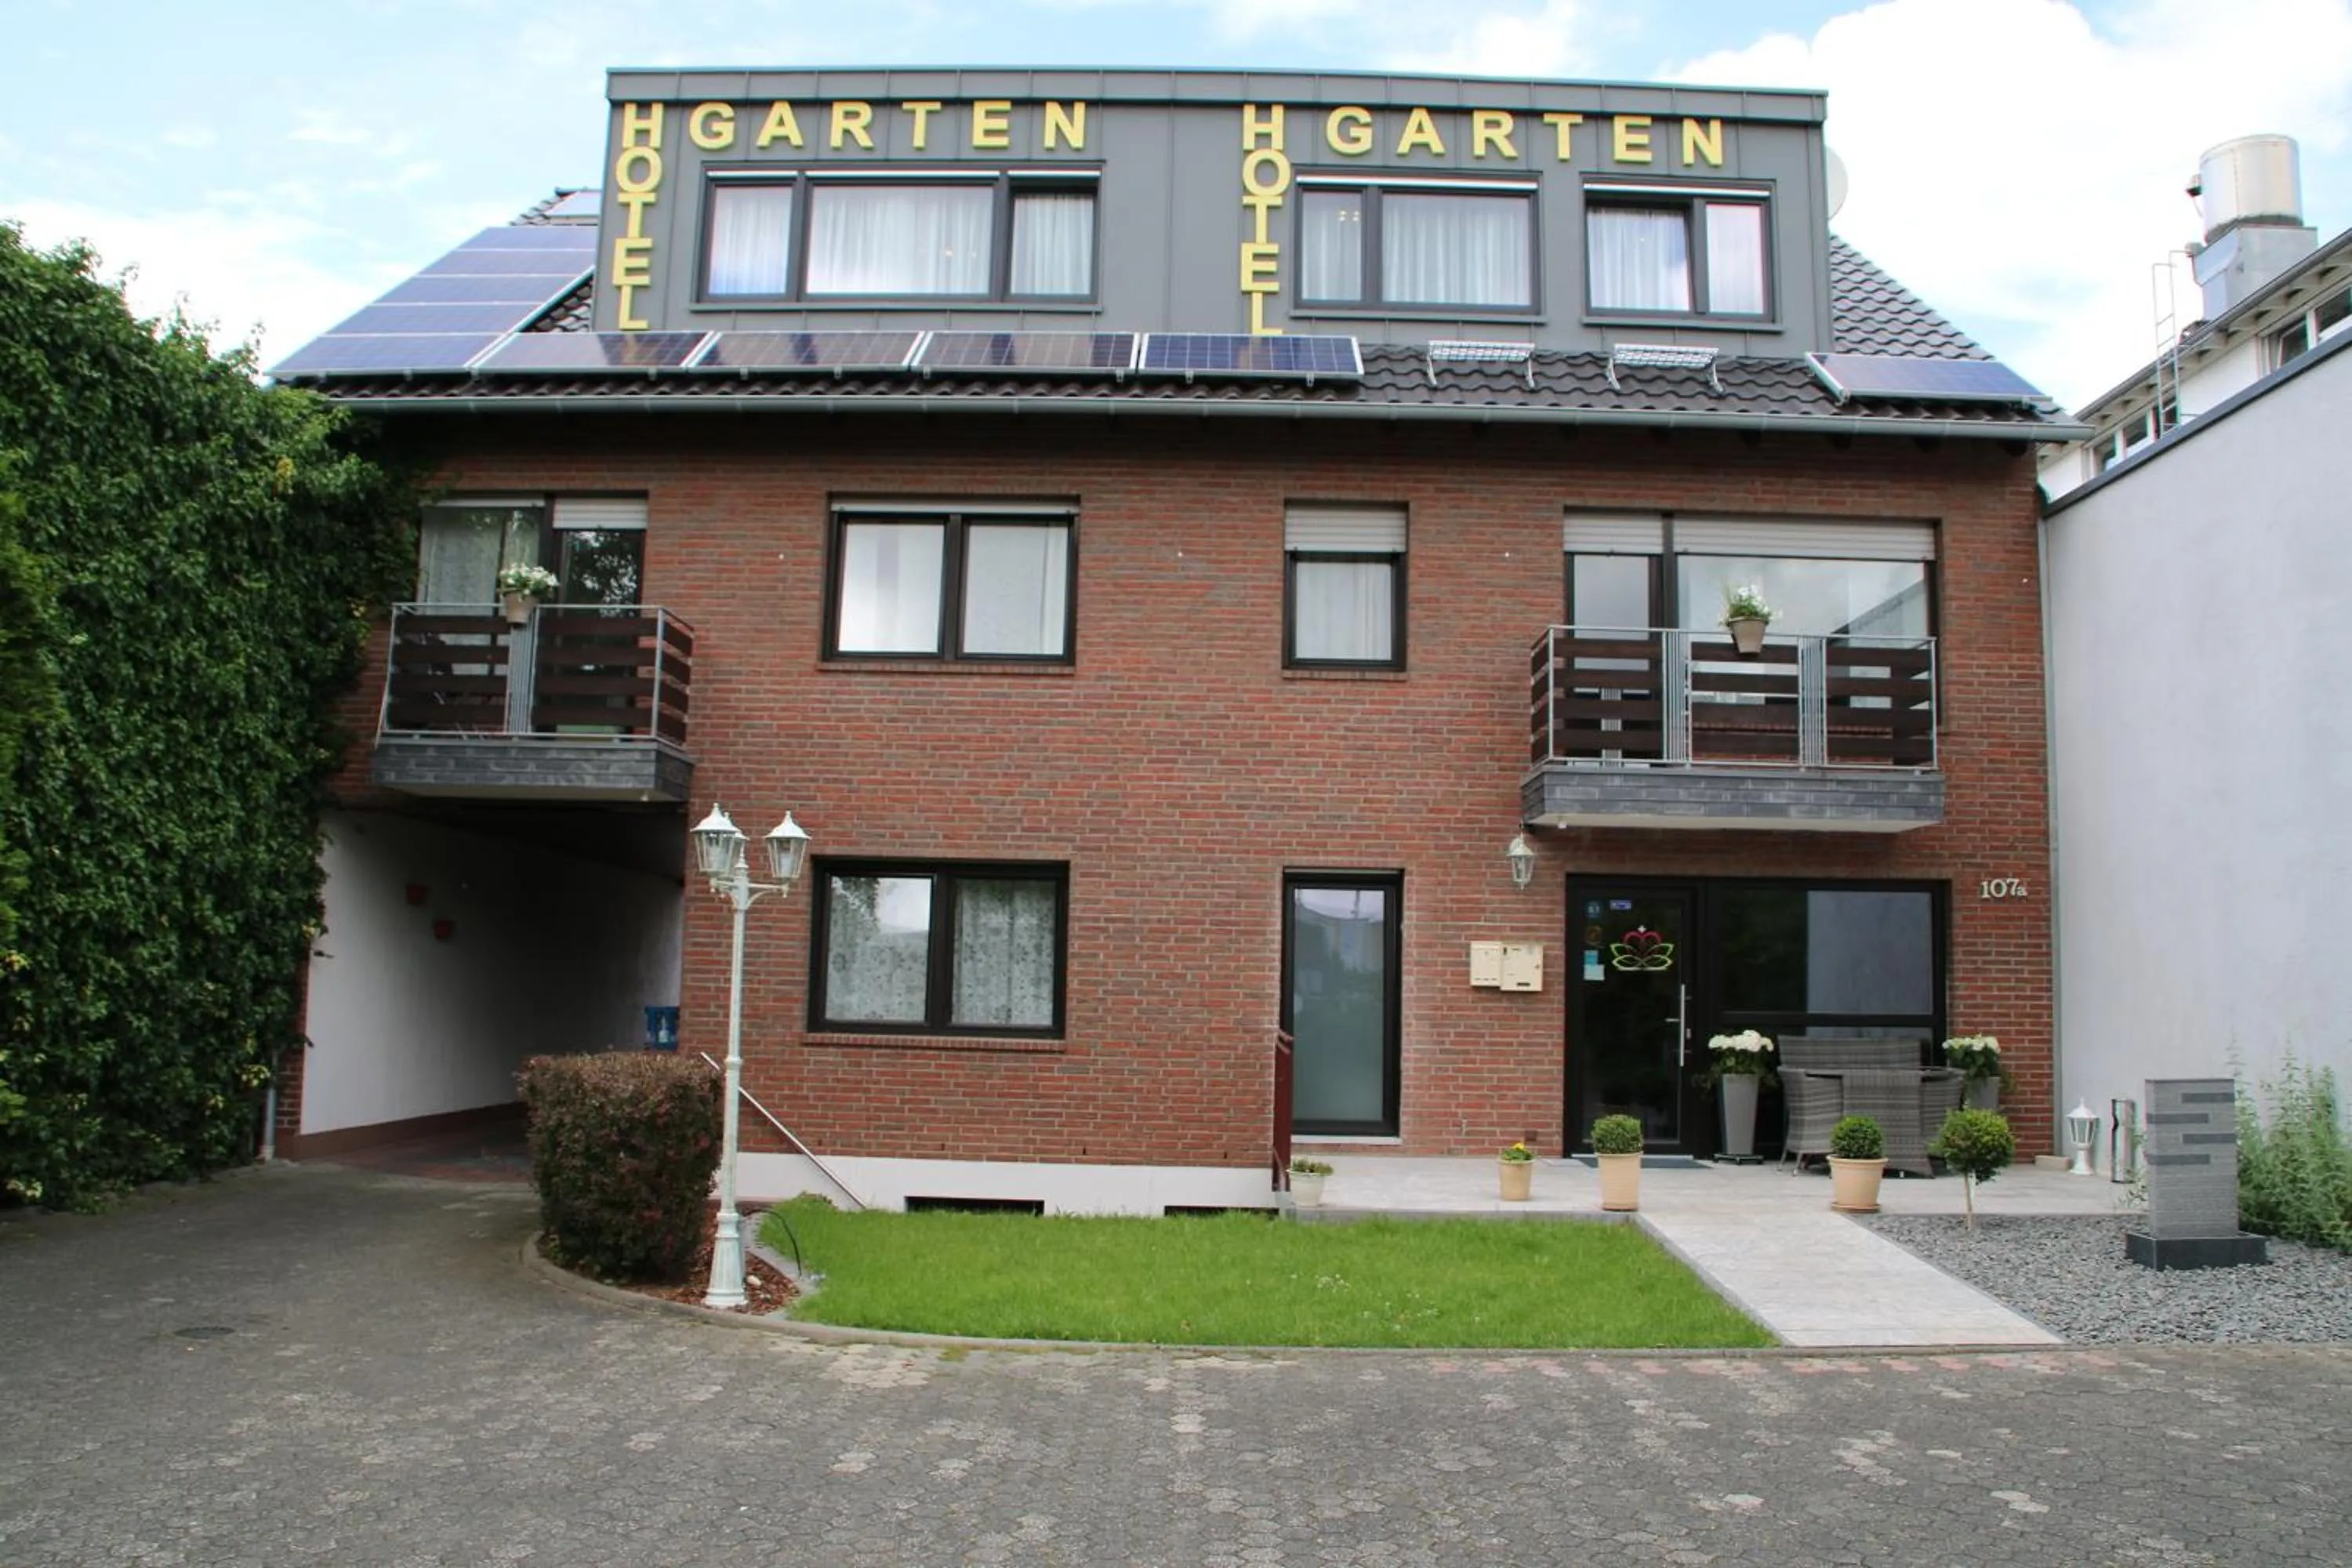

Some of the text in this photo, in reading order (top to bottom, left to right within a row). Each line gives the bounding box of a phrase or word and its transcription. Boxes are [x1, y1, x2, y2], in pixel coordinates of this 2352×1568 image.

[688, 100, 1087, 150] GARTEN
[1326, 106, 1723, 166] GARTEN
[614, 101, 664, 331] HOTEL
[1240, 103, 1291, 336] HOTEL
[1980, 877, 2028, 899] 107a
